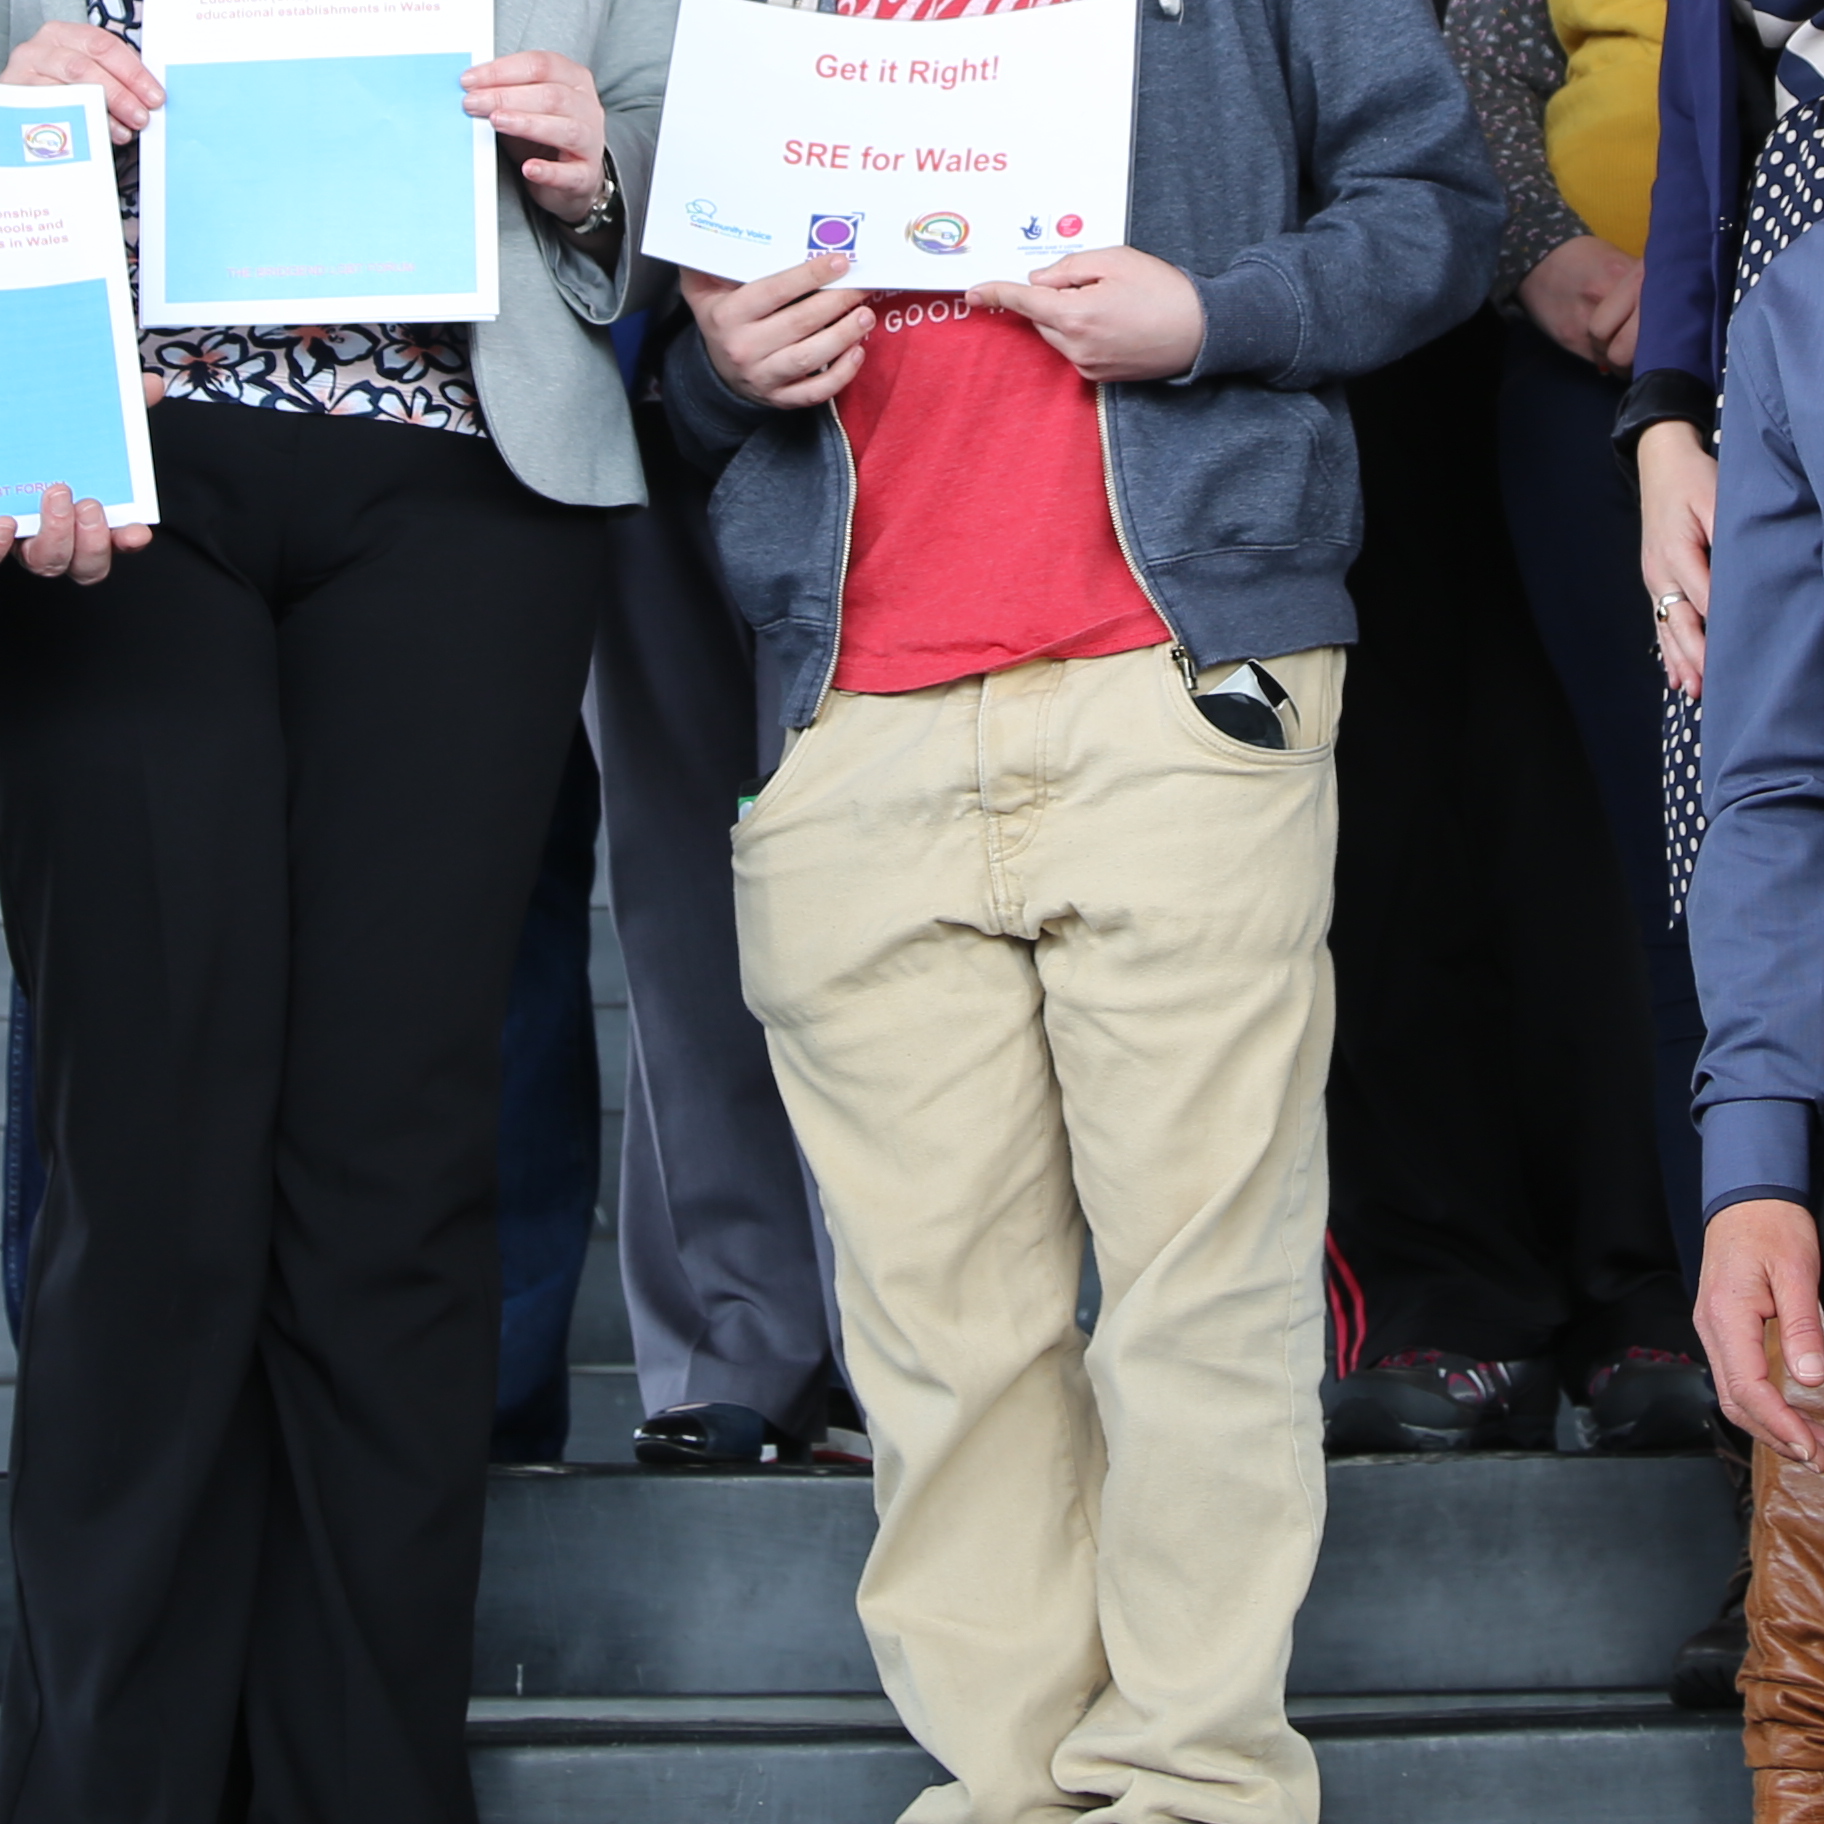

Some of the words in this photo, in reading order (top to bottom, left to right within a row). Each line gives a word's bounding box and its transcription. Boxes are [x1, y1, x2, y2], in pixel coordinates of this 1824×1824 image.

[195, 8, 274, 21] educational
[278, 4, 379, 16] establishments
[384, 2, 396, 12] in
[400, 2, 441, 12] Wales
[815, 54, 869, 82] Get
[878, 56, 898, 84] it
[908, 56, 1001, 91] Right!
[783, 140, 851, 170] SRE
[860, 146, 905, 172] for
[915, 148, 1008, 172] Wales
[38, 219, 64, 231] and
[689, 214, 744, 238] Community
[746, 229, 772, 240] Voice
[9, 238, 22, 249] in
[26, 233, 69, 247] Wales
[884, 297, 972, 334] GOOD
